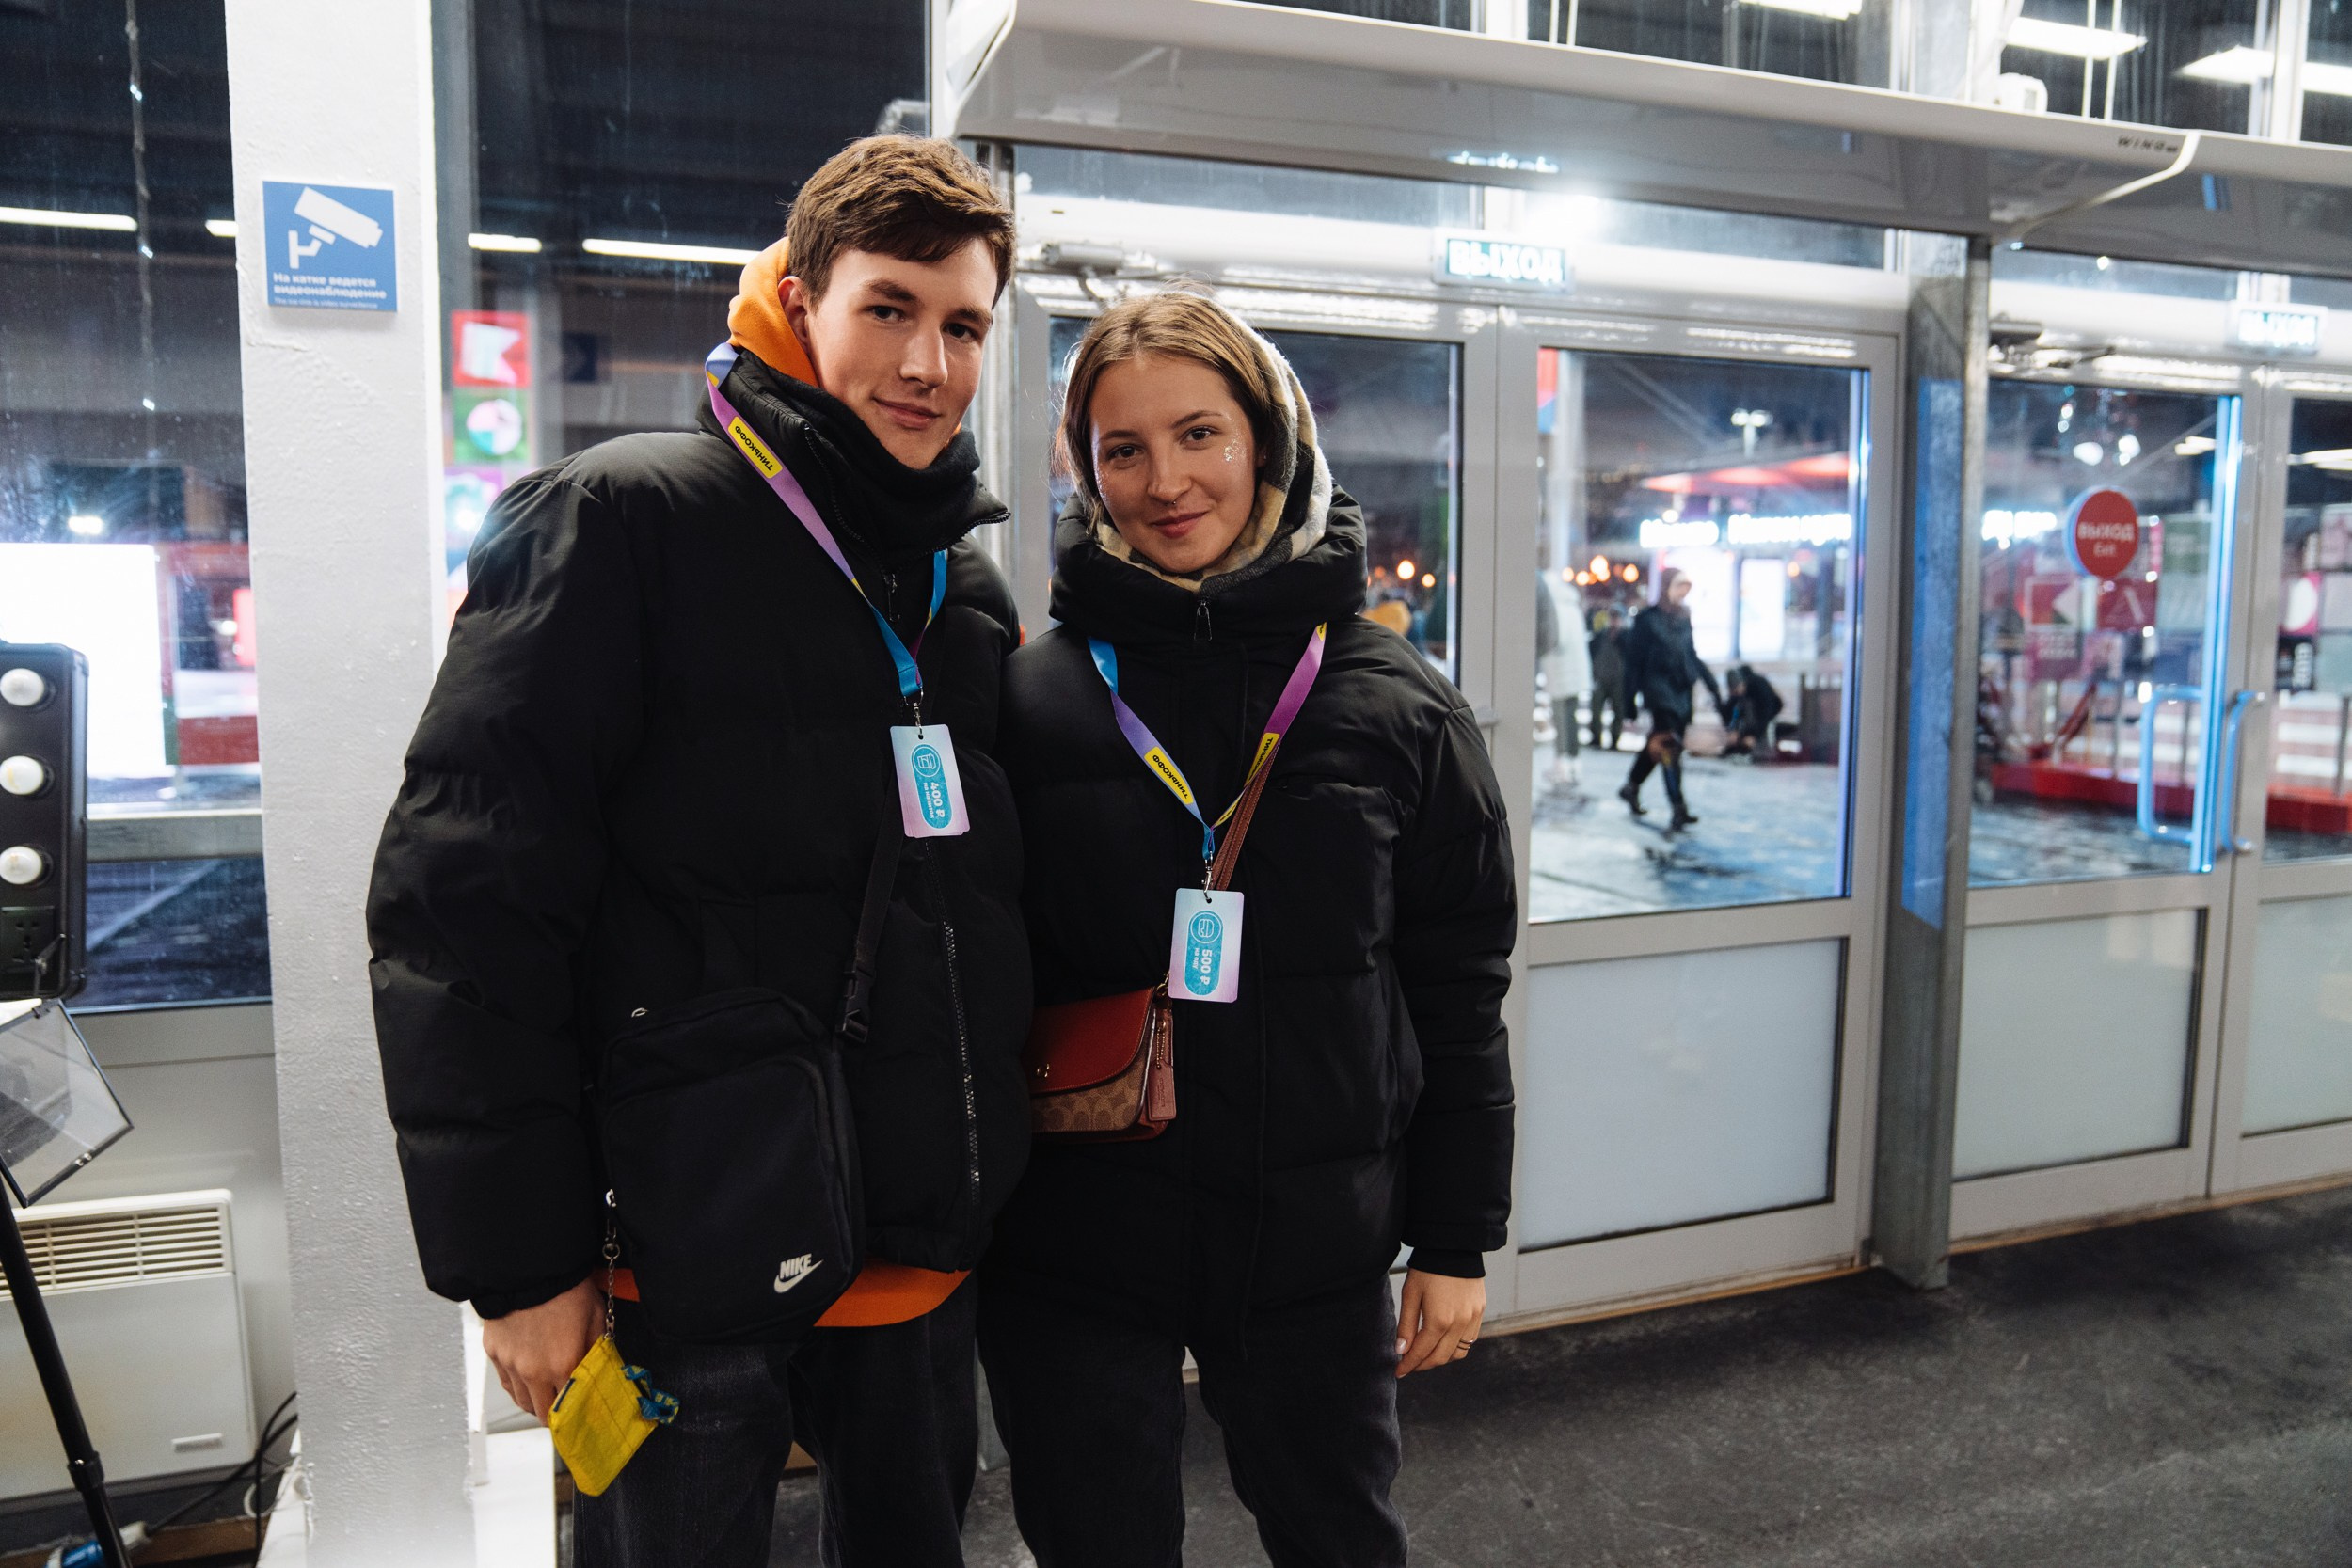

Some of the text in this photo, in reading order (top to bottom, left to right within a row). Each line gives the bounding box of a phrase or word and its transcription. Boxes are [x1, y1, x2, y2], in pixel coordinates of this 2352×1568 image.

[1449, 240, 1563, 283] ВЫХОД
[273, 272, 290, 283] На
[292, 274, 326, 285] катке
[274, 285, 387, 299] видеонаблюдение
[735, 426, 773, 471] ТИНЬКОФФ
[2077, 522, 2135, 542] ВЫХОД
[2093, 542, 2117, 557] Exit
[1152, 754, 1188, 800] ТИНЬКОФФ
[930, 782, 943, 807] 400
[1200, 949, 1213, 974] 500
[780, 1253, 812, 1279] NIKE
